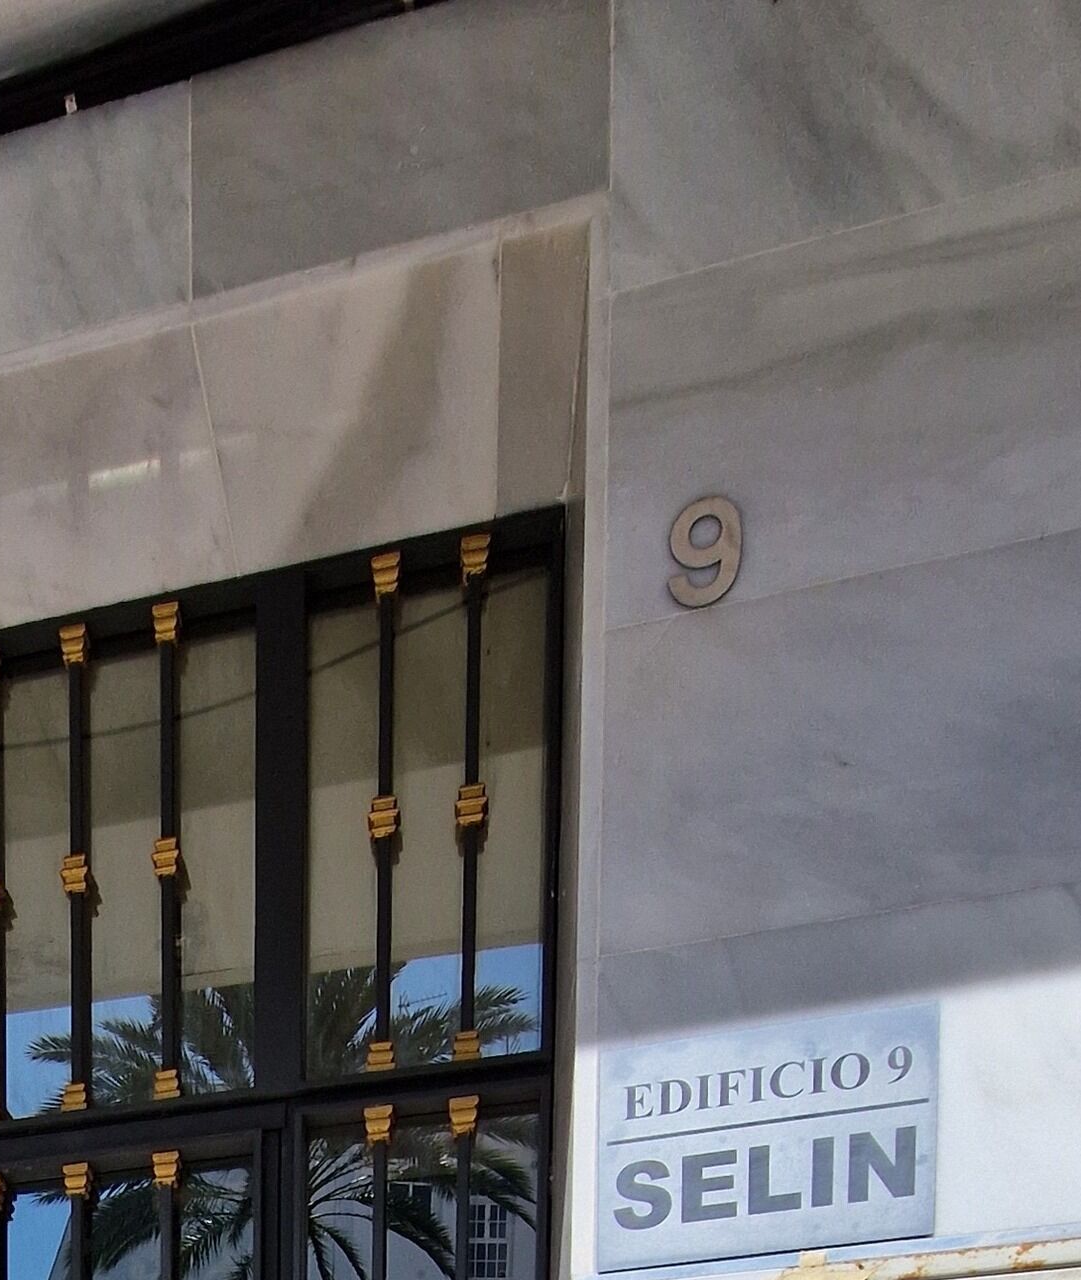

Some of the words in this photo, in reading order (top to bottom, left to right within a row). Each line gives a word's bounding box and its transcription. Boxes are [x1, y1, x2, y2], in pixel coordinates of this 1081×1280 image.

[666, 494, 743, 609] 9
[624, 1052, 871, 1121] EDIFICIO
[887, 1046, 914, 1085] 9
[613, 1125, 918, 1231] SELIN
